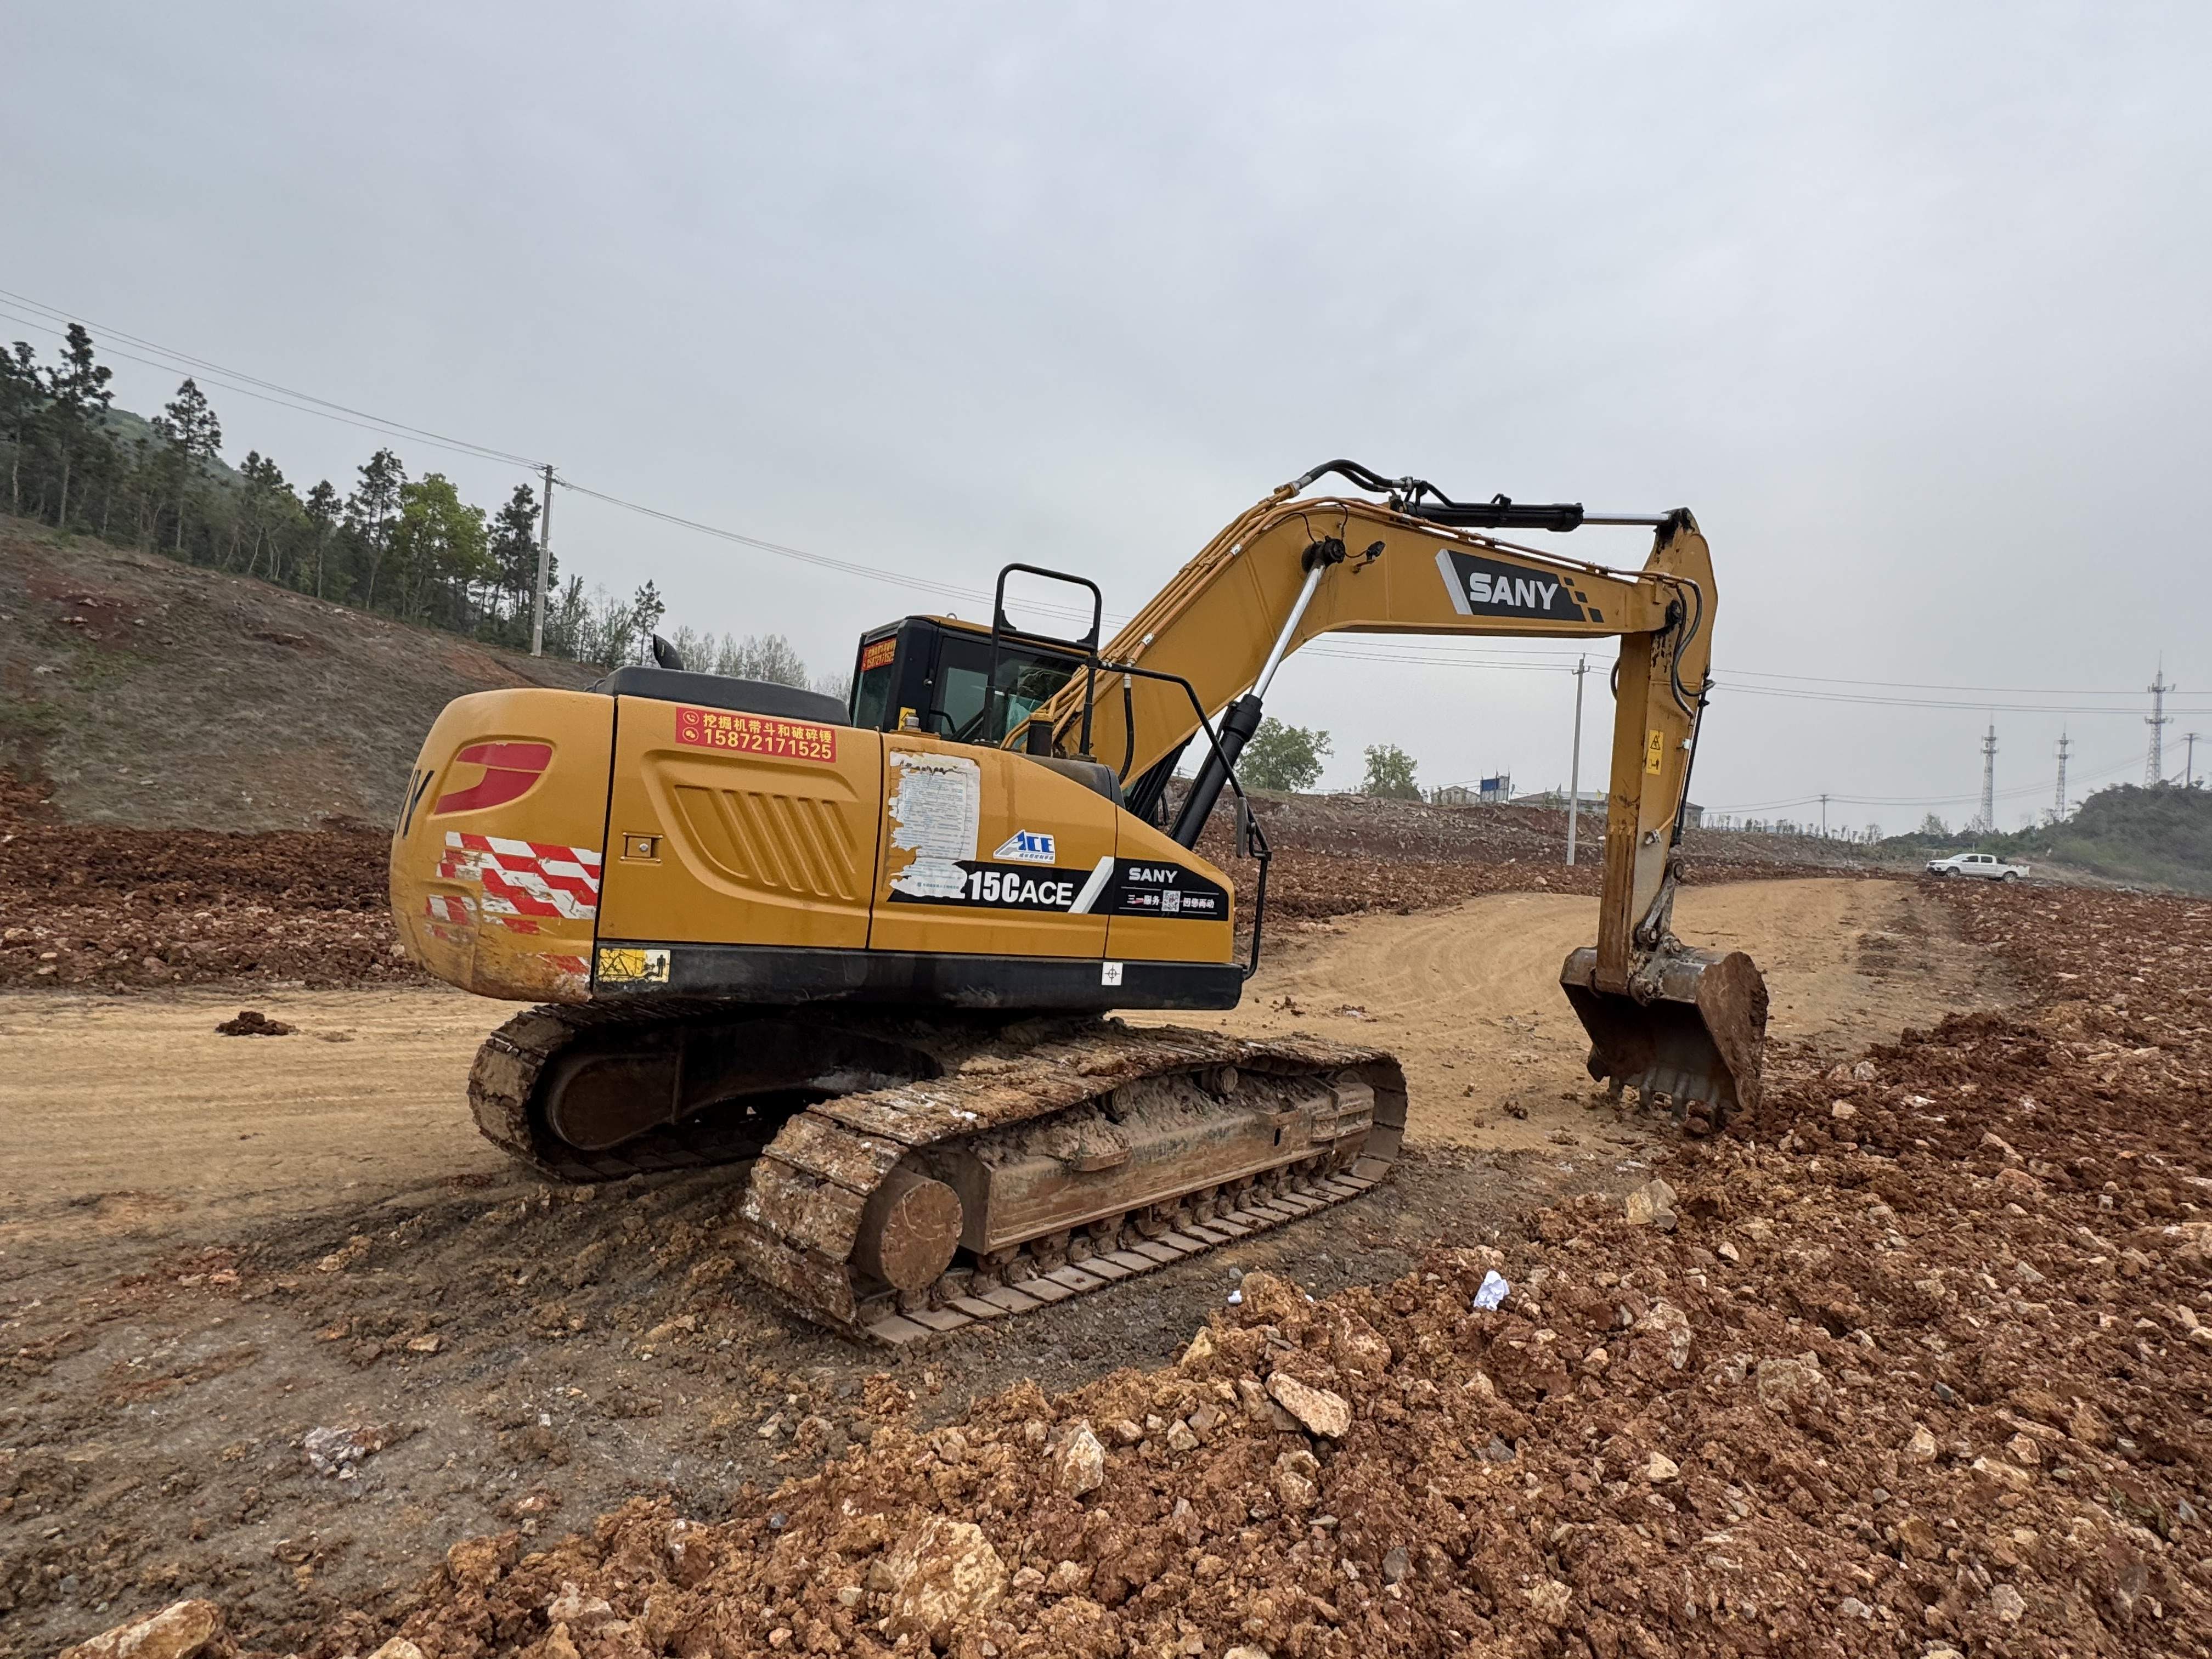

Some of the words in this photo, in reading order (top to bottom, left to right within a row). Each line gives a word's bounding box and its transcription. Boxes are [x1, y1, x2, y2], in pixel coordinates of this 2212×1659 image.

[1469, 572, 1559, 610] SANY
[703, 713, 832, 744] 挖掘机带斗和破碎锤
[703, 729, 832, 760] 15872171525
[1128, 867, 1178, 883] SANY
